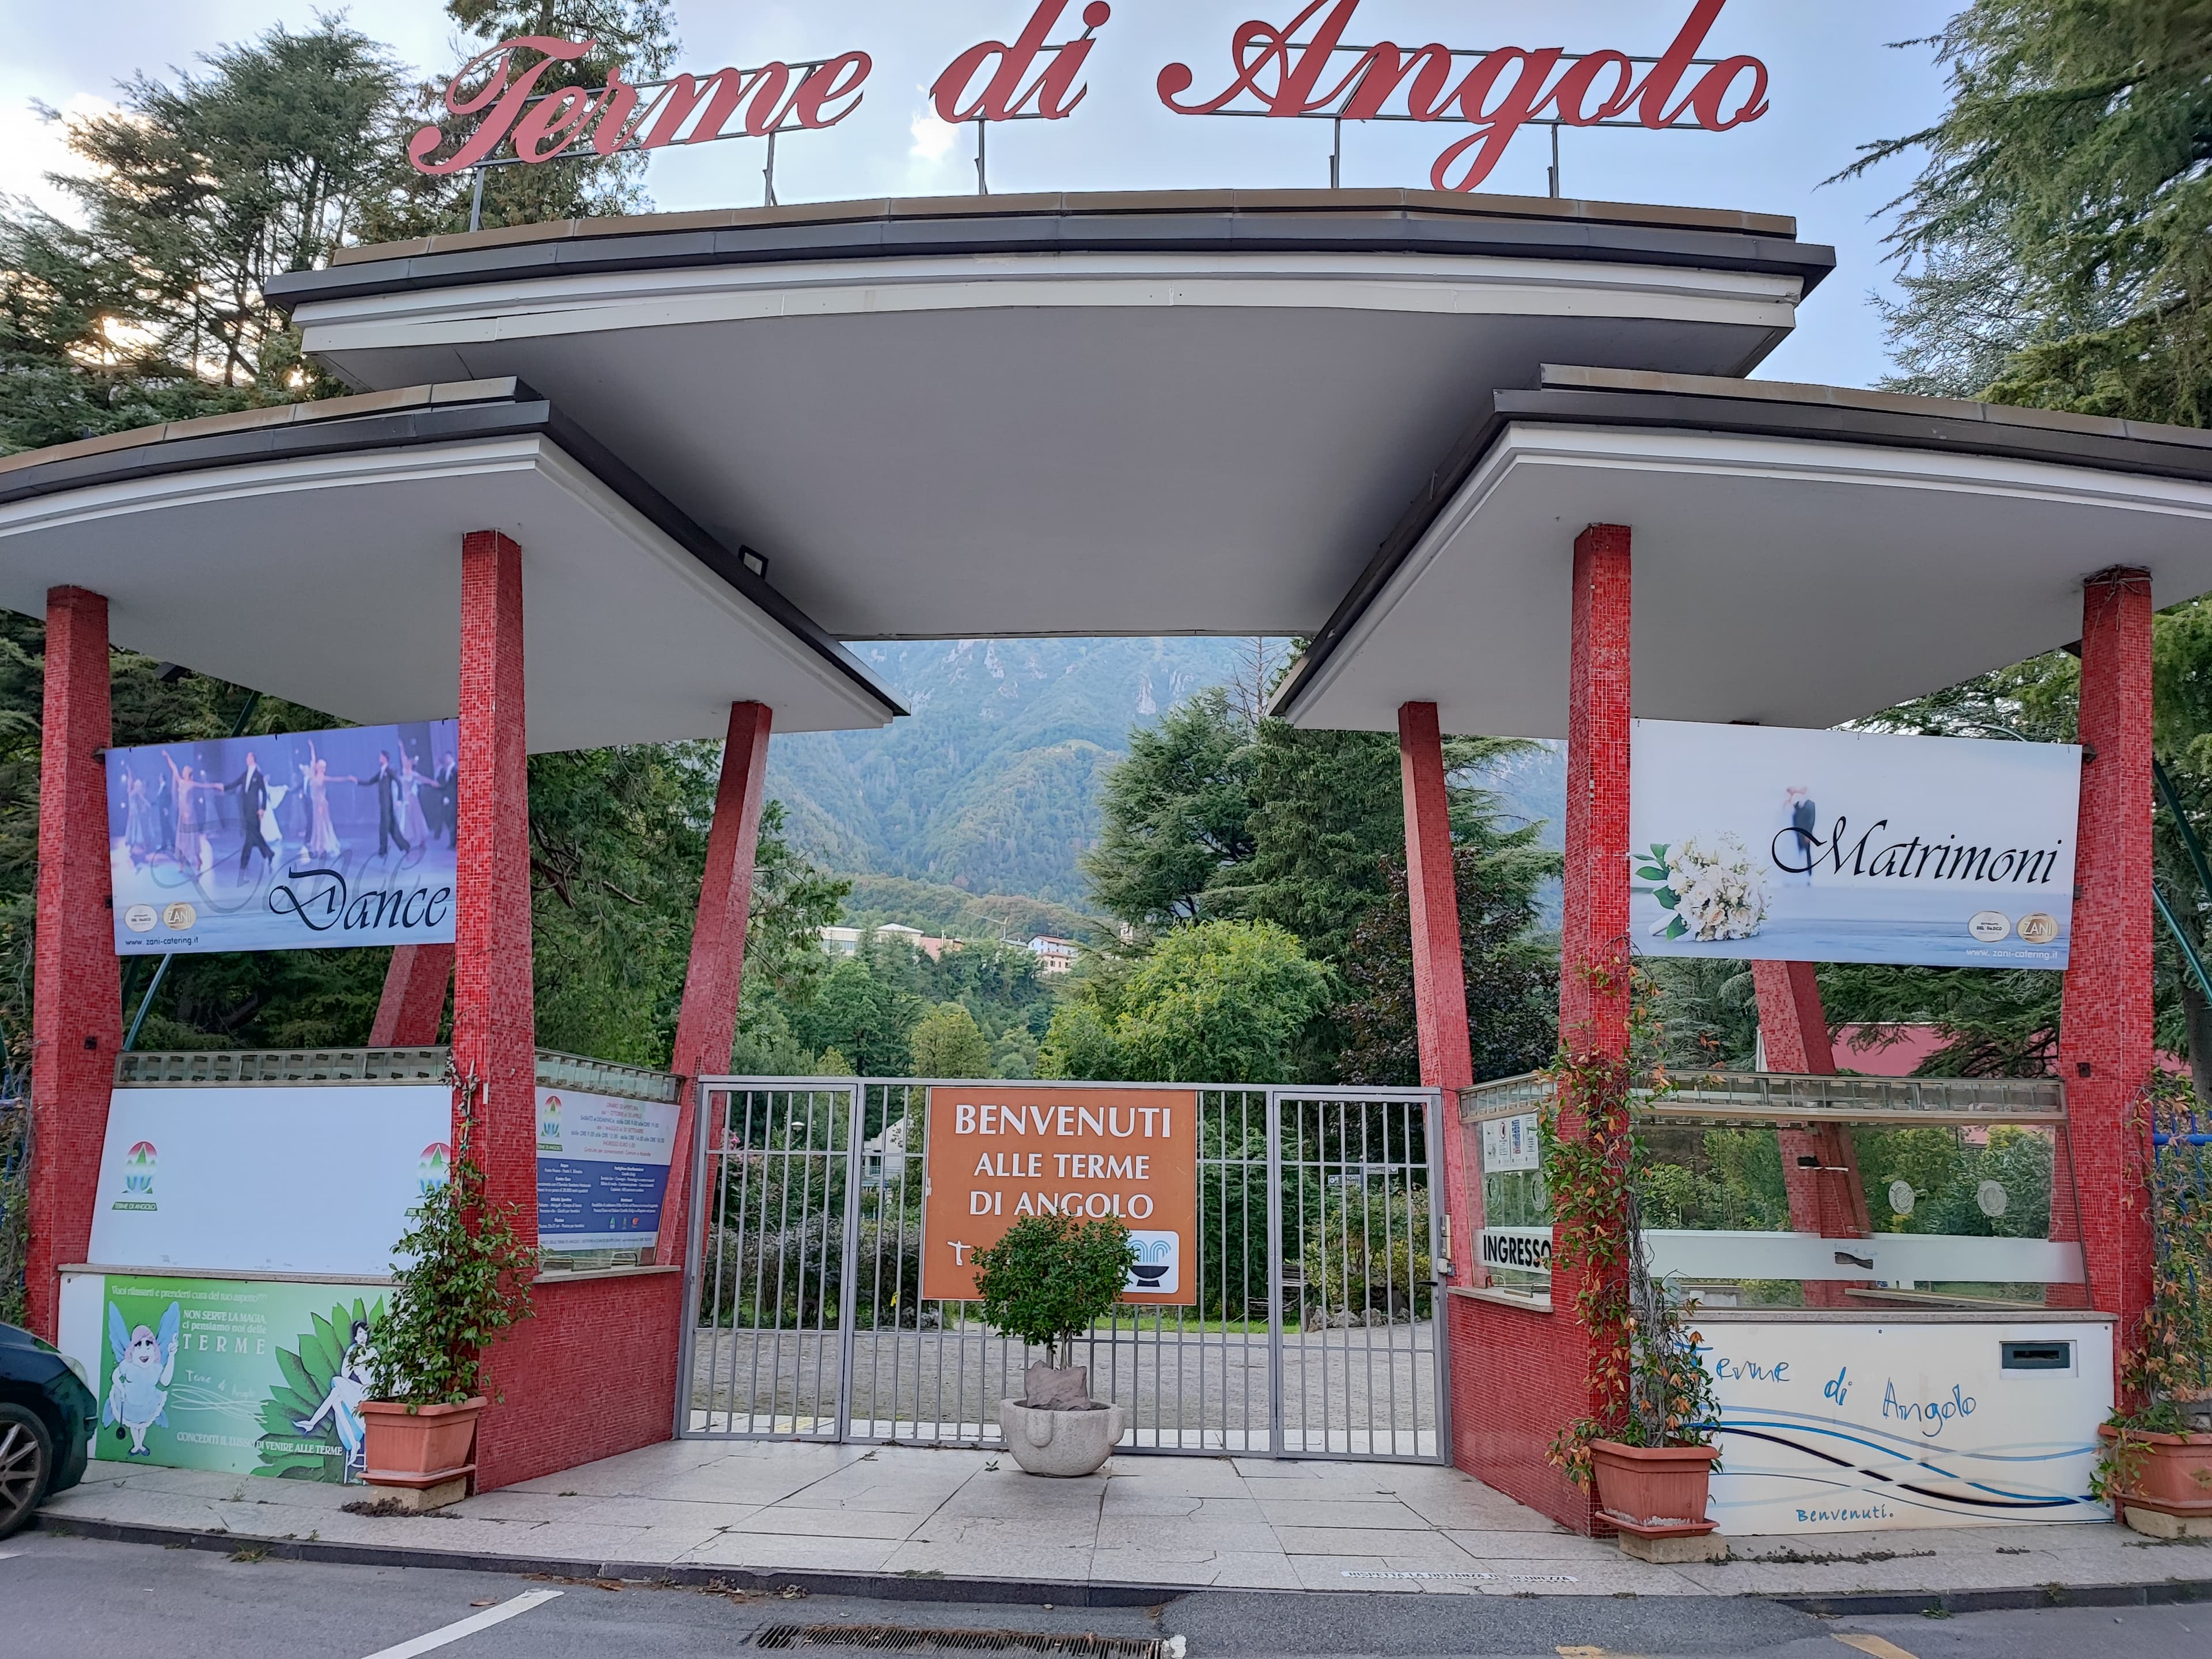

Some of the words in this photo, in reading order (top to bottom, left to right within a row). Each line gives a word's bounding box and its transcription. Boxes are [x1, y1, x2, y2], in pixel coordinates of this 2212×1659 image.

[408, 35, 873, 175] Terme
[929, 0, 1111, 123] di
[1157, 0, 1769, 192] Angolo
[1771, 815, 2062, 884] Matrimoni
[268, 866, 450, 931] Dance
[168, 910, 192, 924] ZANI
[2022, 922, 2052, 936] ZANI
[146, 935, 199, 946] zani-catering.it
[1993, 949, 2059, 961] zani-catering.it
[955, 1104, 1172, 1138] BENVENUTI
[973, 1152, 1043, 1177] ALLE
[1052, 1153, 1150, 1180] TERME
[969, 1190, 1002, 1216] DI
[1013, 1191, 1154, 1220] ANGOLO
[1483, 1234, 1552, 1268] INGRESSO
[112, 1285, 127, 1296] Vuoi
[191, 1291, 207, 1300] cura
[208, 1291, 219, 1300] del
[183, 1309, 201, 1320] NON
[201, 1310, 227, 1321] SERVE
[228, 1312, 239, 1322] LA
[191, 1322, 230, 1331] pensiamo
[232, 1324, 245, 1332] noi
[247, 1324, 267, 1334] delle
[1674, 1342, 1790, 1383] Terme
[1824, 1366, 1853, 1406] di
[1883, 1376, 1977, 1438] Angolo
[256, 1440, 265, 1449] DI
[265, 1441, 294, 1452] VENIRE
[294, 1442, 314, 1454] ALLE
[315, 1445, 343, 1456] TERME
[1796, 1503, 1894, 1522] Benvenuti.
